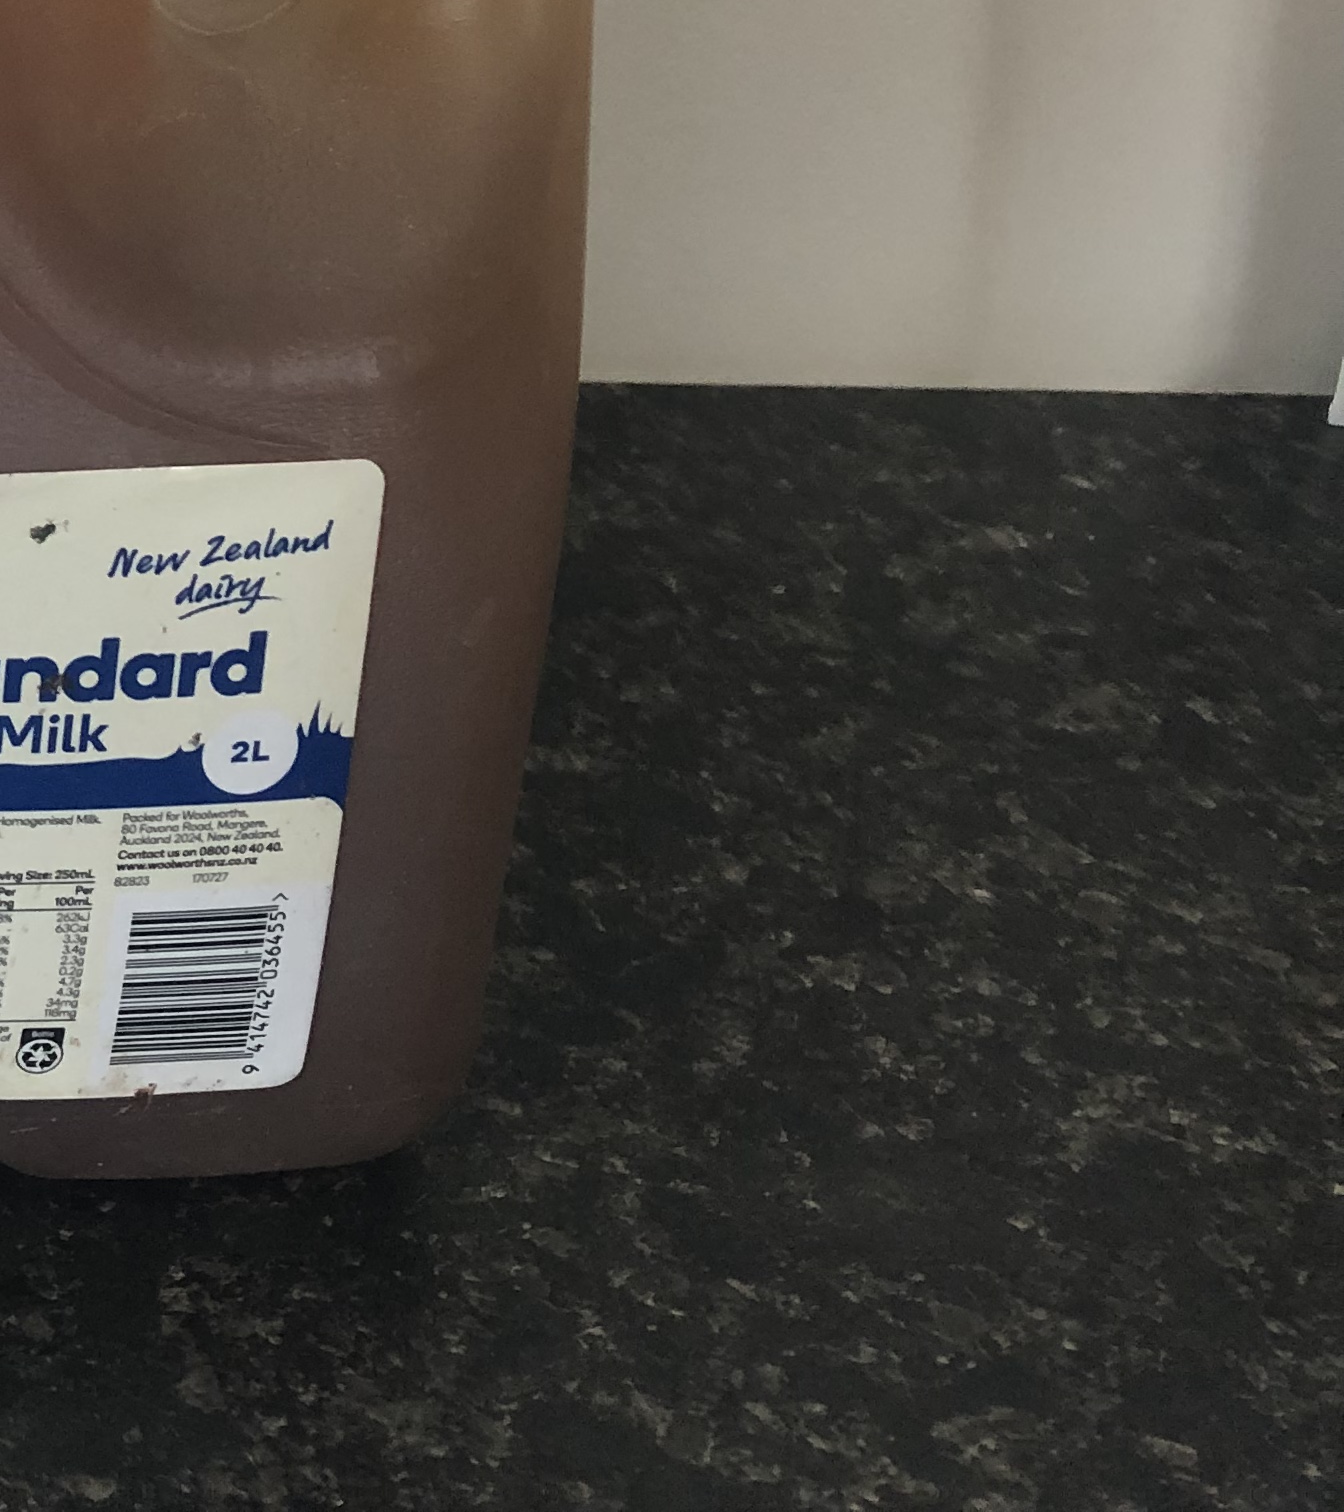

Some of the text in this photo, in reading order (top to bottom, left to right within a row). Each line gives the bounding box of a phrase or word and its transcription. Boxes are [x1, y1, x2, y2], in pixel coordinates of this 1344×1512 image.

[107, 519, 334, 577] New Zealand
[175, 573, 266, 614] dairy
[229, 741, 270, 764] 2L
[123, 813, 162, 823] Packed
[166, 811, 180, 820] for
[121, 824, 137, 834] 80
[120, 836, 172, 845] Auckland
[207, 832, 232, 841] New
[118, 850, 165, 860] Contact
[200, 845, 230, 856] 0800
[232, 845, 247, 854] 40
[249, 843, 264, 853] 40
[26, 870, 52, 880] Size:
[55, 869, 95, 880] 250mL
[75, 886, 94, 895] Per
[55, 897, 93, 906] 100mL
[242, 911, 286, 1074] 9 414742 036455
[0, 1034, 12, 1042] of
